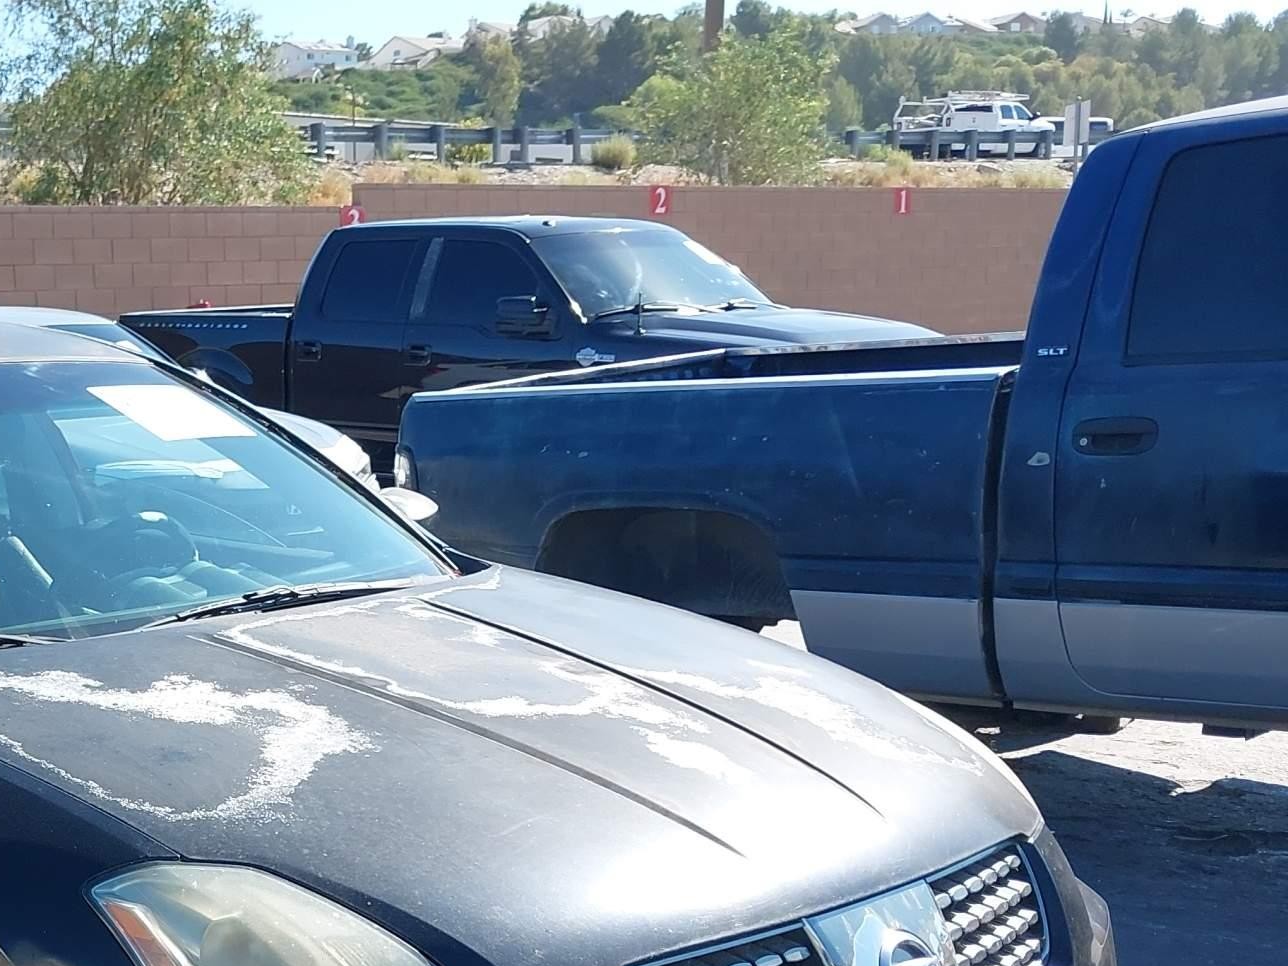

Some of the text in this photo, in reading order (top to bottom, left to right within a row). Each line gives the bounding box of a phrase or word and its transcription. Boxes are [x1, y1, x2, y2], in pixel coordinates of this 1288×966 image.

[655, 187, 666, 213] 2
[899, 190, 907, 214] 1
[1037, 347, 1068, 356] SLT
